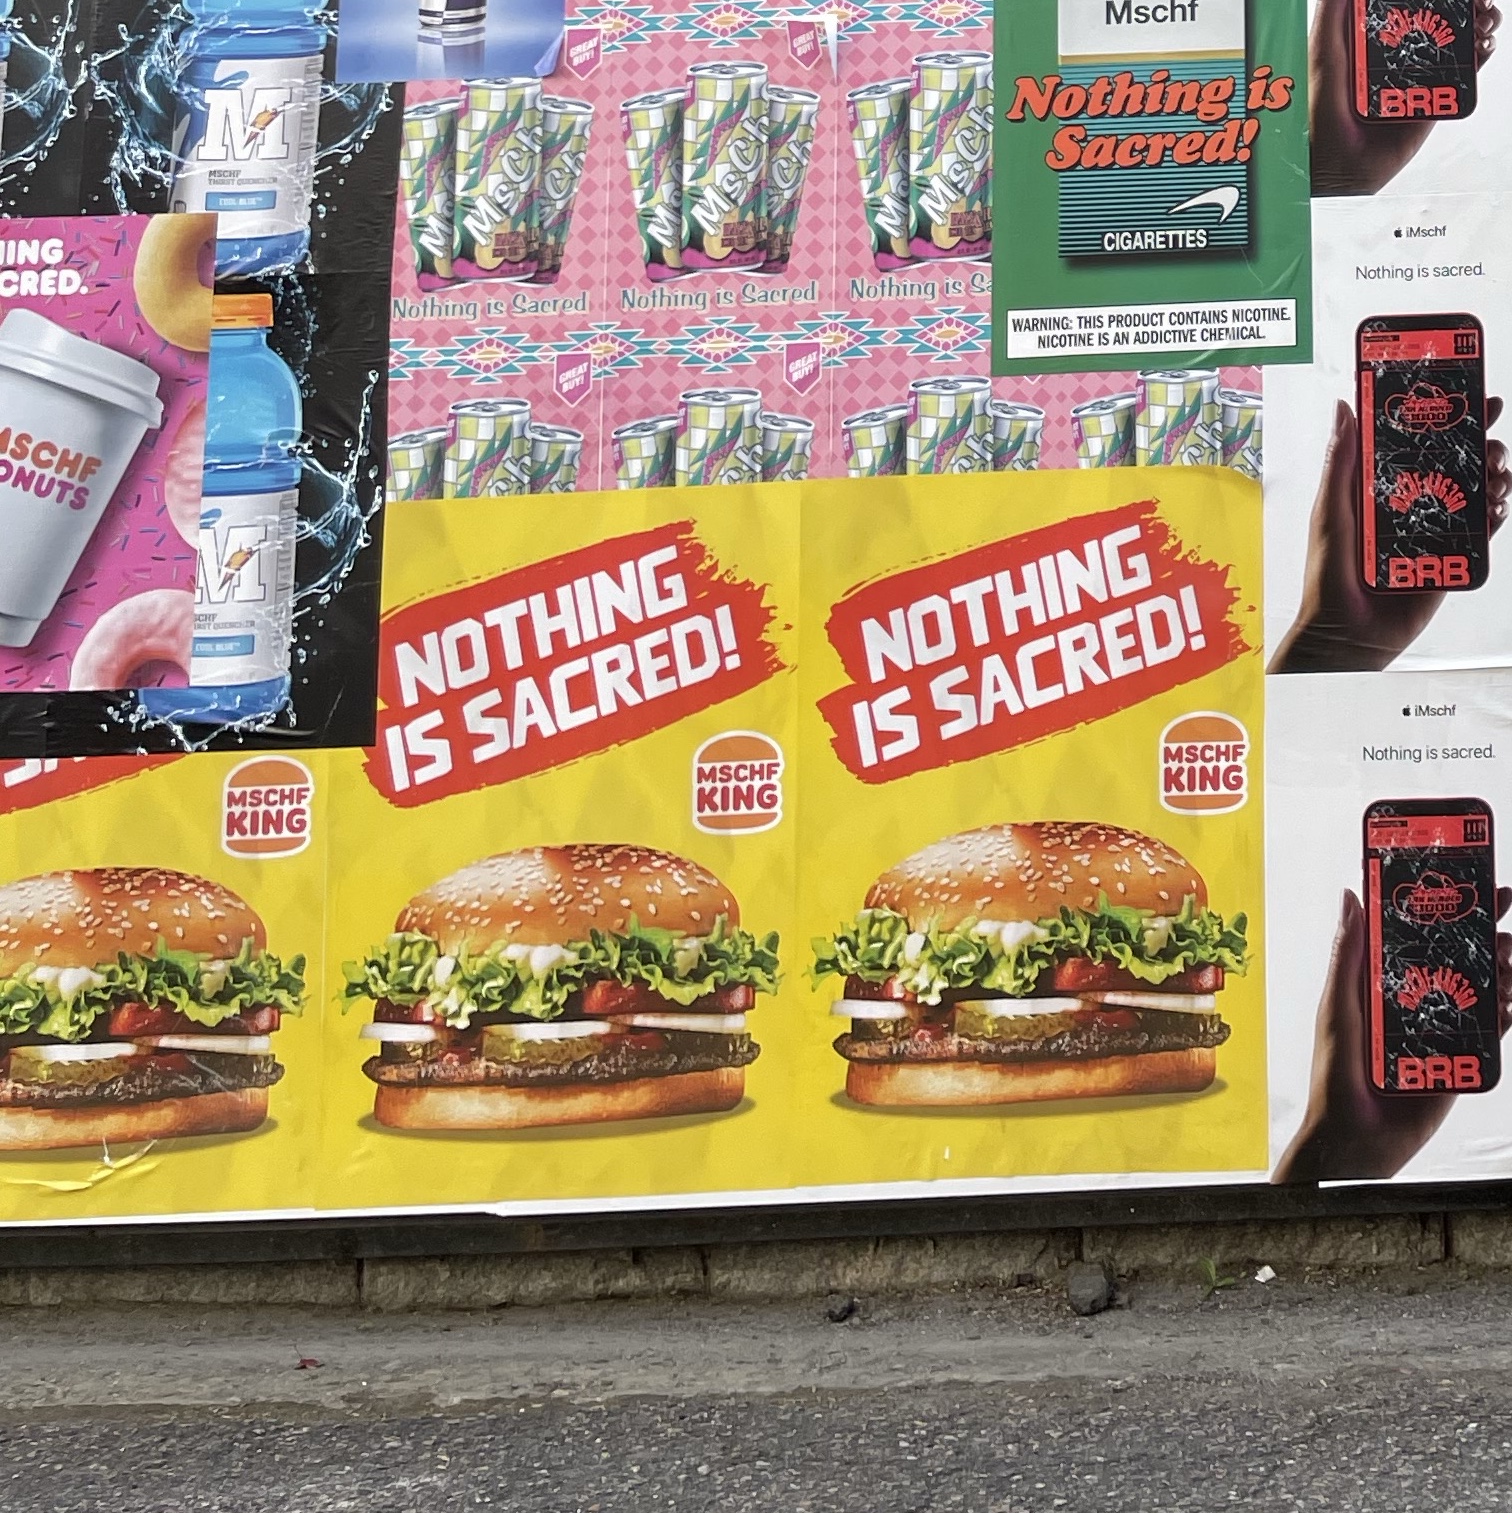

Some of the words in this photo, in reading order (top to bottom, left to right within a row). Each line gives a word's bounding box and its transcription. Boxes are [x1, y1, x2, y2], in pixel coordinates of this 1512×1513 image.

[570, 38, 599, 57] GREAT
[1005, 68, 1238, 123] Nothing
[1247, 64, 1295, 112] is
[1380, 86, 1459, 117] BRB
[197, 87, 293, 161] M
[1044, 116, 1261, 170] Sacred!
[208, 170, 241, 178] MSCHF
[1102, 228, 1208, 251] CIGARETTES
[1405, 224, 1447, 239] iMschf
[1355, 265, 1413, 282] Nothing
[1416, 264, 1430, 279] is
[1432, 262, 1486, 279] sacred.
[392, 296, 478, 319] Nothing
[487, 297, 503, 314] is
[512, 291, 587, 313] Sacred
[621, 287, 707, 310] Nothing
[717, 287, 733, 304] is
[742, 281, 815, 303] Sacred
[1012, 317, 1073, 333] WARNING:
[1077, 315, 1104, 330] THIS
[1108, 312, 1165, 328] PRODUCT
[1168, 309, 1228, 326] CONTAINS
[1232, 307, 1291, 323] NICOTINE.
[1037, 332, 1094, 349] NICOTINE
[1097, 332, 1110, 346] IS
[1113, 331, 1130, 346] AN
[1133, 328, 1197, 345] ADDICTIVE
[1200, 326, 1266, 343] CHEMICAL.
[1388, 555, 1470, 588] BRB
[860, 524, 1152, 683] NOTHING
[394, 544, 688, 707] NOTHING
[851, 693, 920, 769] IS
[930, 585, 1206, 741] SACRED!
[385, 717, 455, 793] IS
[470, 603, 742, 762] SACRED!
[1414, 703, 1456, 718] iMschf
[1163, 743, 1245, 766] MSCHF
[1362, 745, 1422, 763] Nothing
[1425, 745, 1439, 760] is
[1441, 743, 1496, 760] sacred.
[697, 762, 781, 784] MSCHF
[1163, 766, 1244, 793] KING
[225, 785, 311, 810] MSCHF
[697, 786, 778, 814] KING
[225, 809, 307, 837] KING
[1397, 1056, 1482, 1089] BRB
